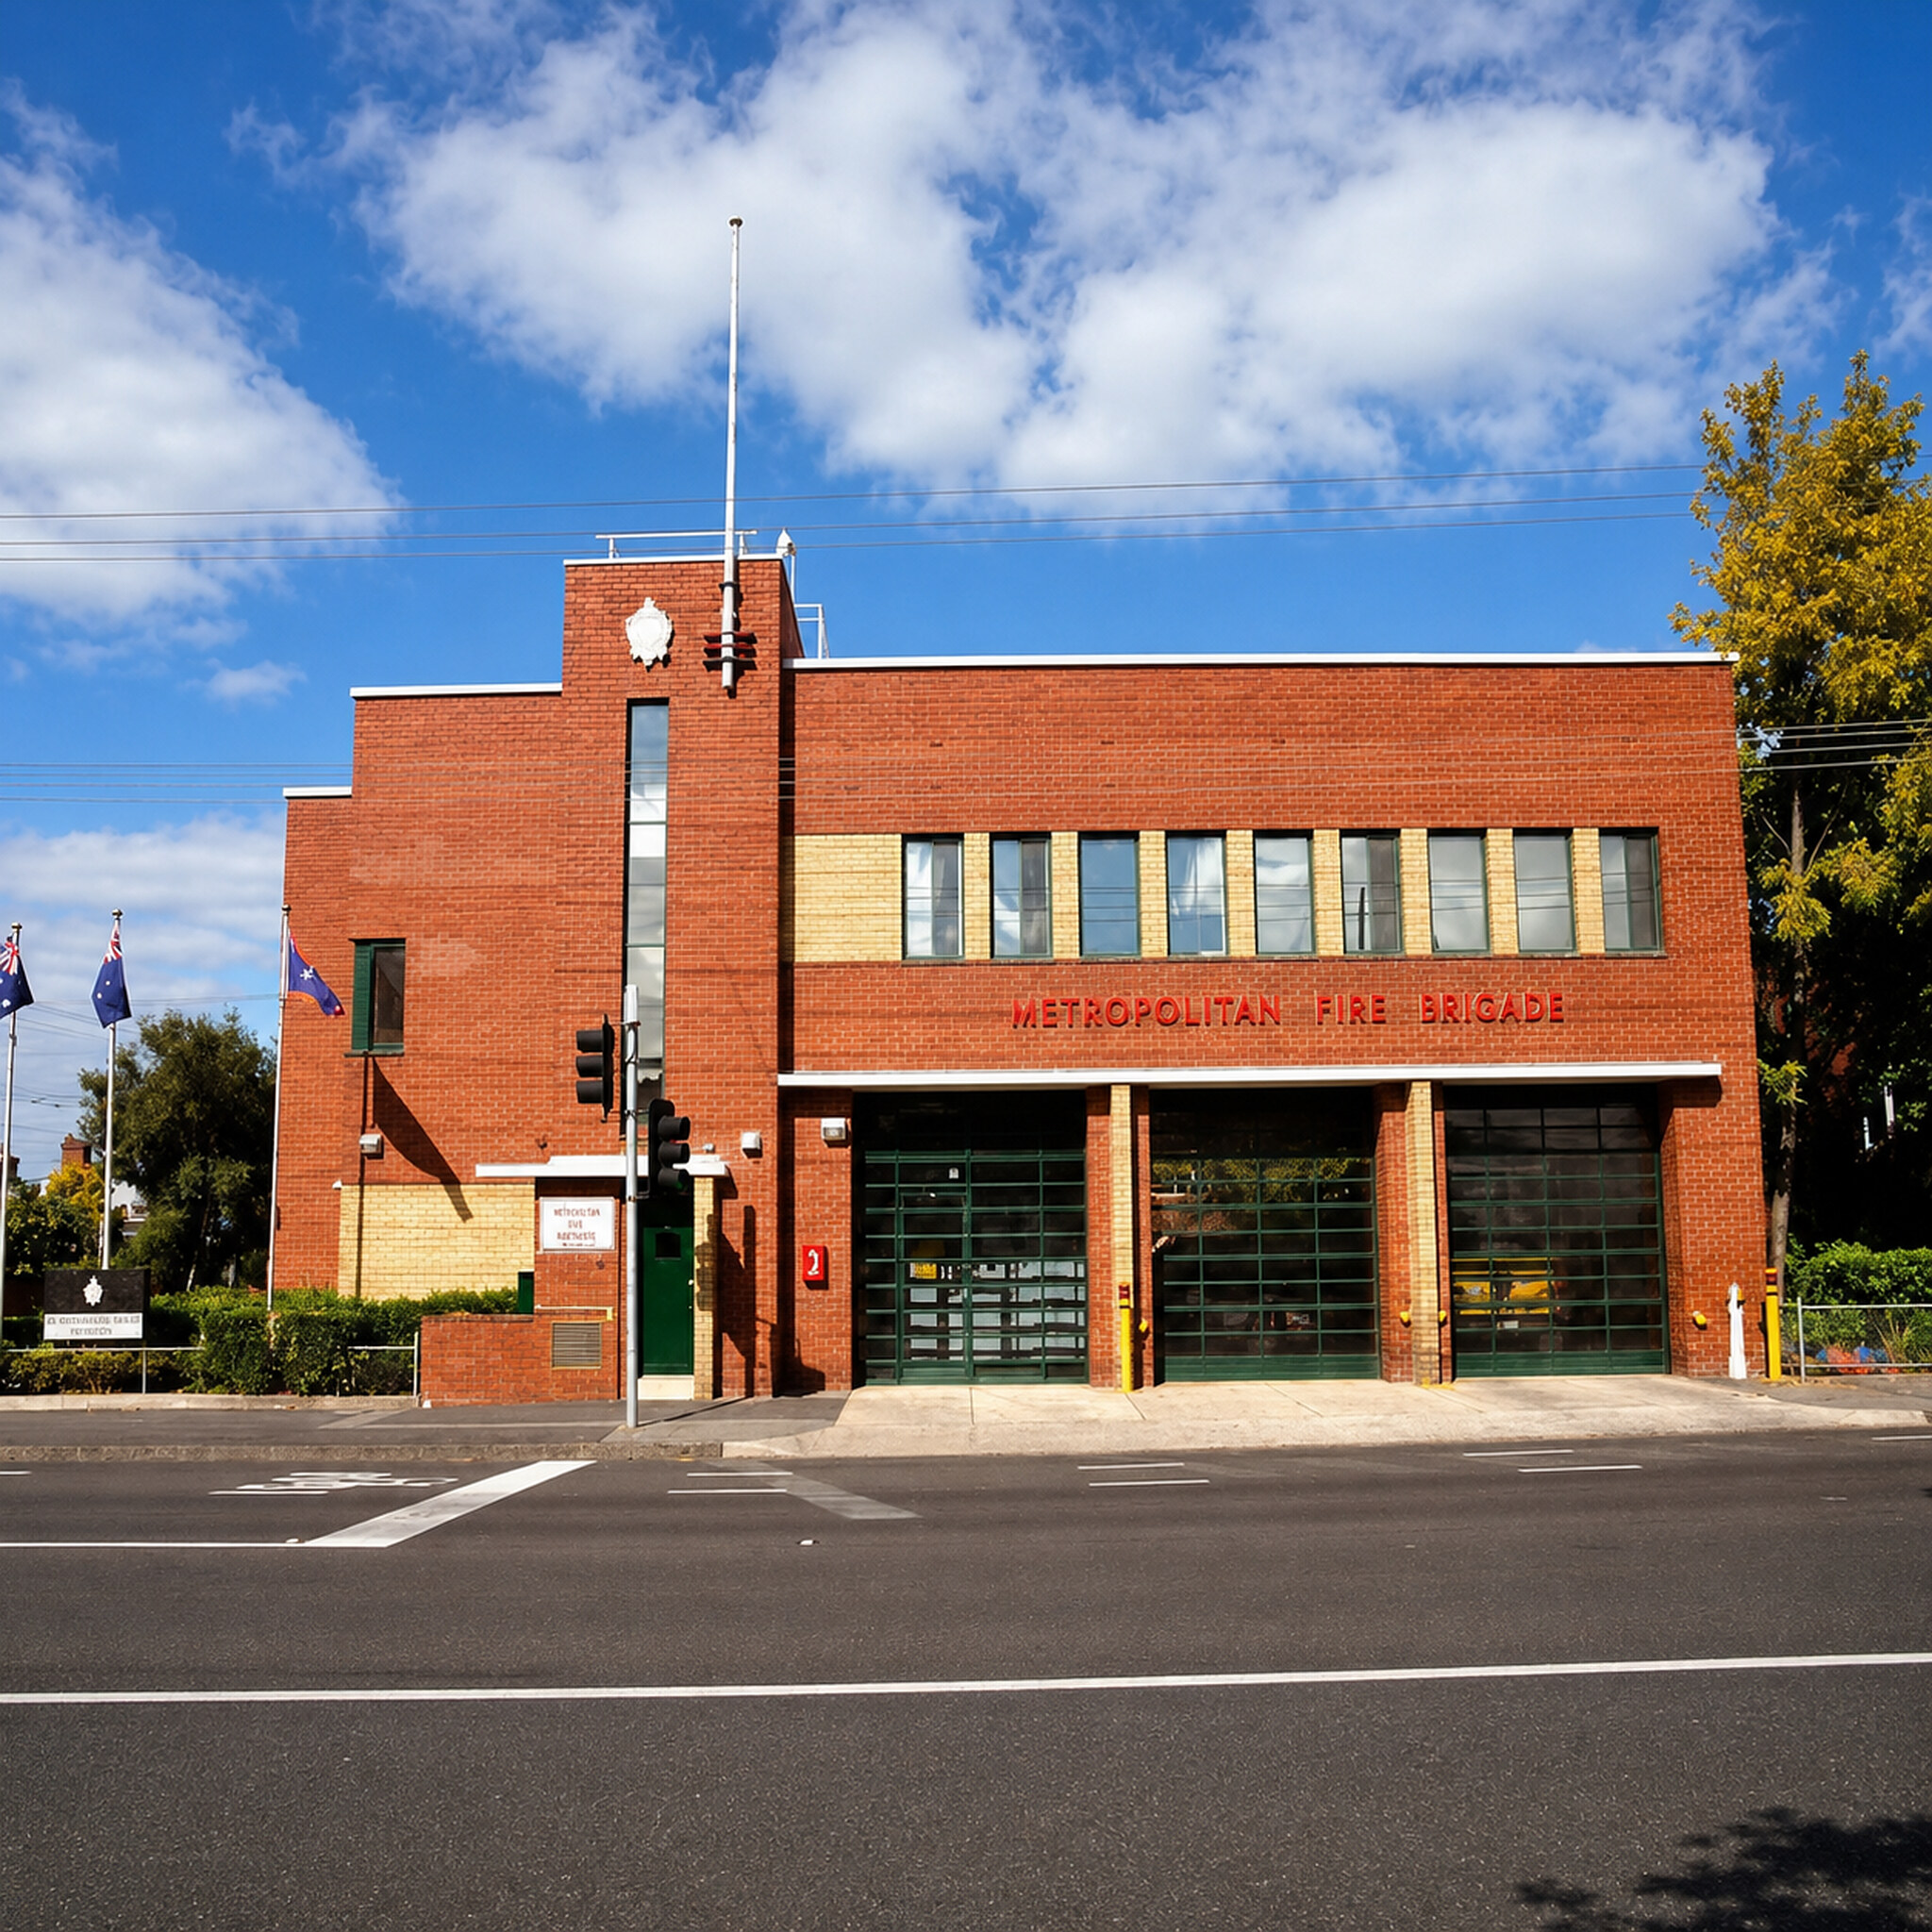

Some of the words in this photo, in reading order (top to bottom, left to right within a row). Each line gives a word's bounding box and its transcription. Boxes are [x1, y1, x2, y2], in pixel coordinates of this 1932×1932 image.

[1012, 995, 1281, 1028] METROPOLITAN
[1315, 992, 1387, 1024] FIRE
[1420, 991, 1564, 1024] BRIGADE
